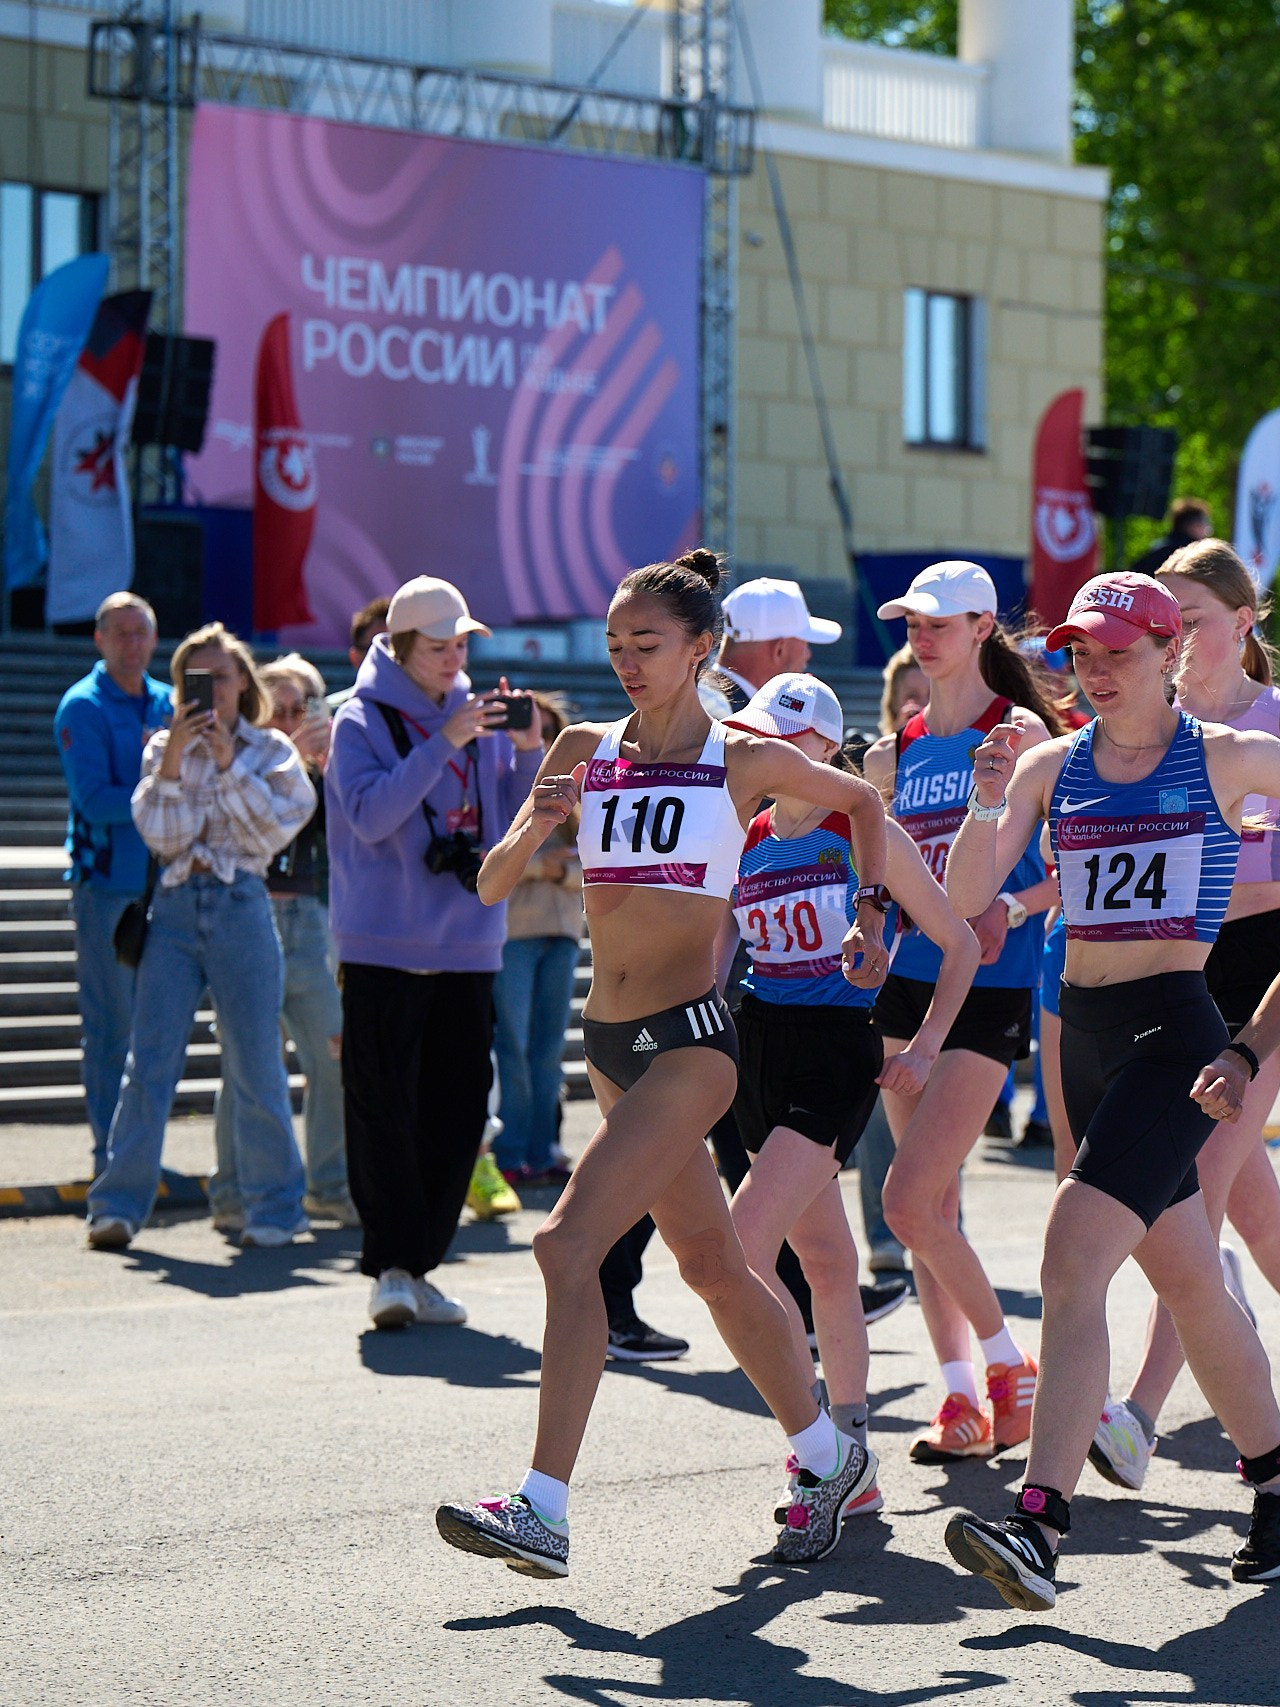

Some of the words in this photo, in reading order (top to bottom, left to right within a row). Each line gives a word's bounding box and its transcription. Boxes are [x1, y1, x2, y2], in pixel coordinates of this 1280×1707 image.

[302, 253, 615, 334] ЧЕМПИОНАТ
[303, 320, 516, 389] РОССИИ
[1081, 588, 1135, 612] SSIA
[659, 770, 710, 781] РОССИИ
[601, 795, 685, 854] 110
[1062, 823, 1136, 834] ЧЕМПИОНАТ
[1138, 821, 1190, 832] РОССИИ
[1071, 833, 1102, 841] ходьбе
[792, 872, 836, 883] РОССИИ
[1084, 852, 1167, 911] 124
[748, 901, 822, 952] 210
[632, 1041, 658, 1052] adidas
